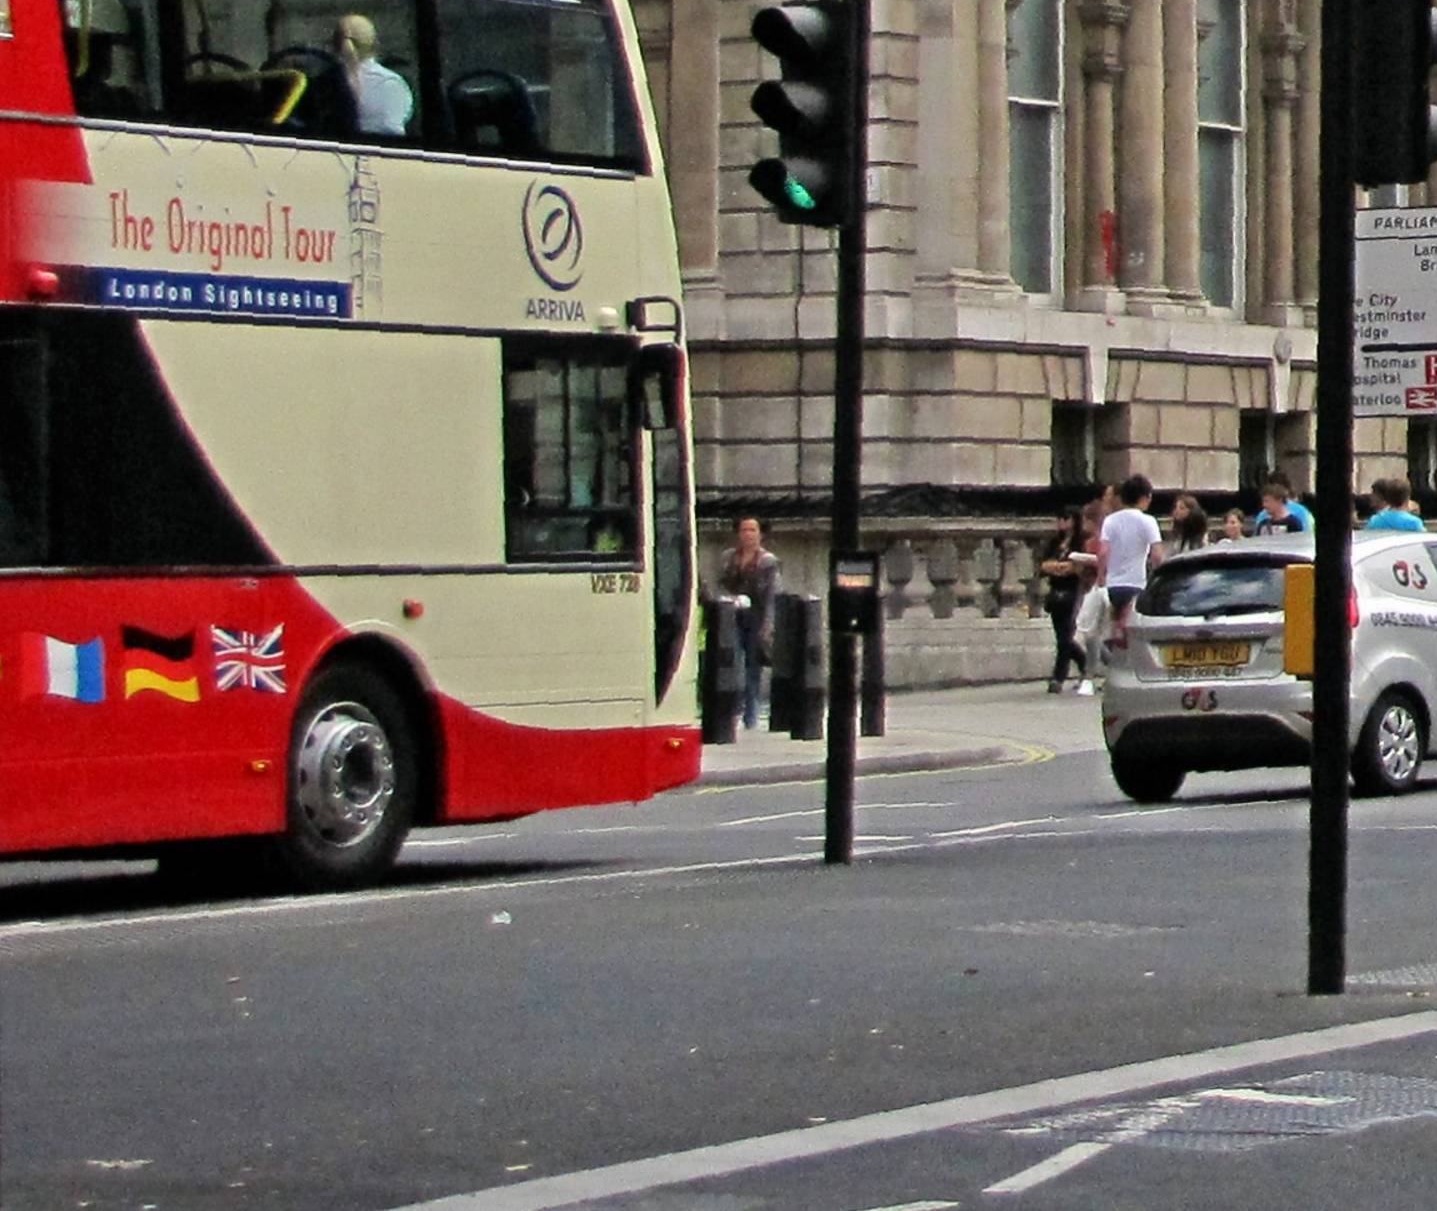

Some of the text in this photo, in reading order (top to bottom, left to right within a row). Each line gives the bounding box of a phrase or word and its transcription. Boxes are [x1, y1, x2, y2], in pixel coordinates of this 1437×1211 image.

[109, 188, 336, 272] The Original Tour
[110, 277, 340, 315] London Sightseeing
[1369, 292, 1398, 308] City
[525, 297, 587, 322] ARRIVA
[1353, 309, 1426, 323] estminster
[1363, 356, 1417, 369] Thomas
[1353, 372, 1401, 387] ospital
[1352, 393, 1402, 406] aterloo
